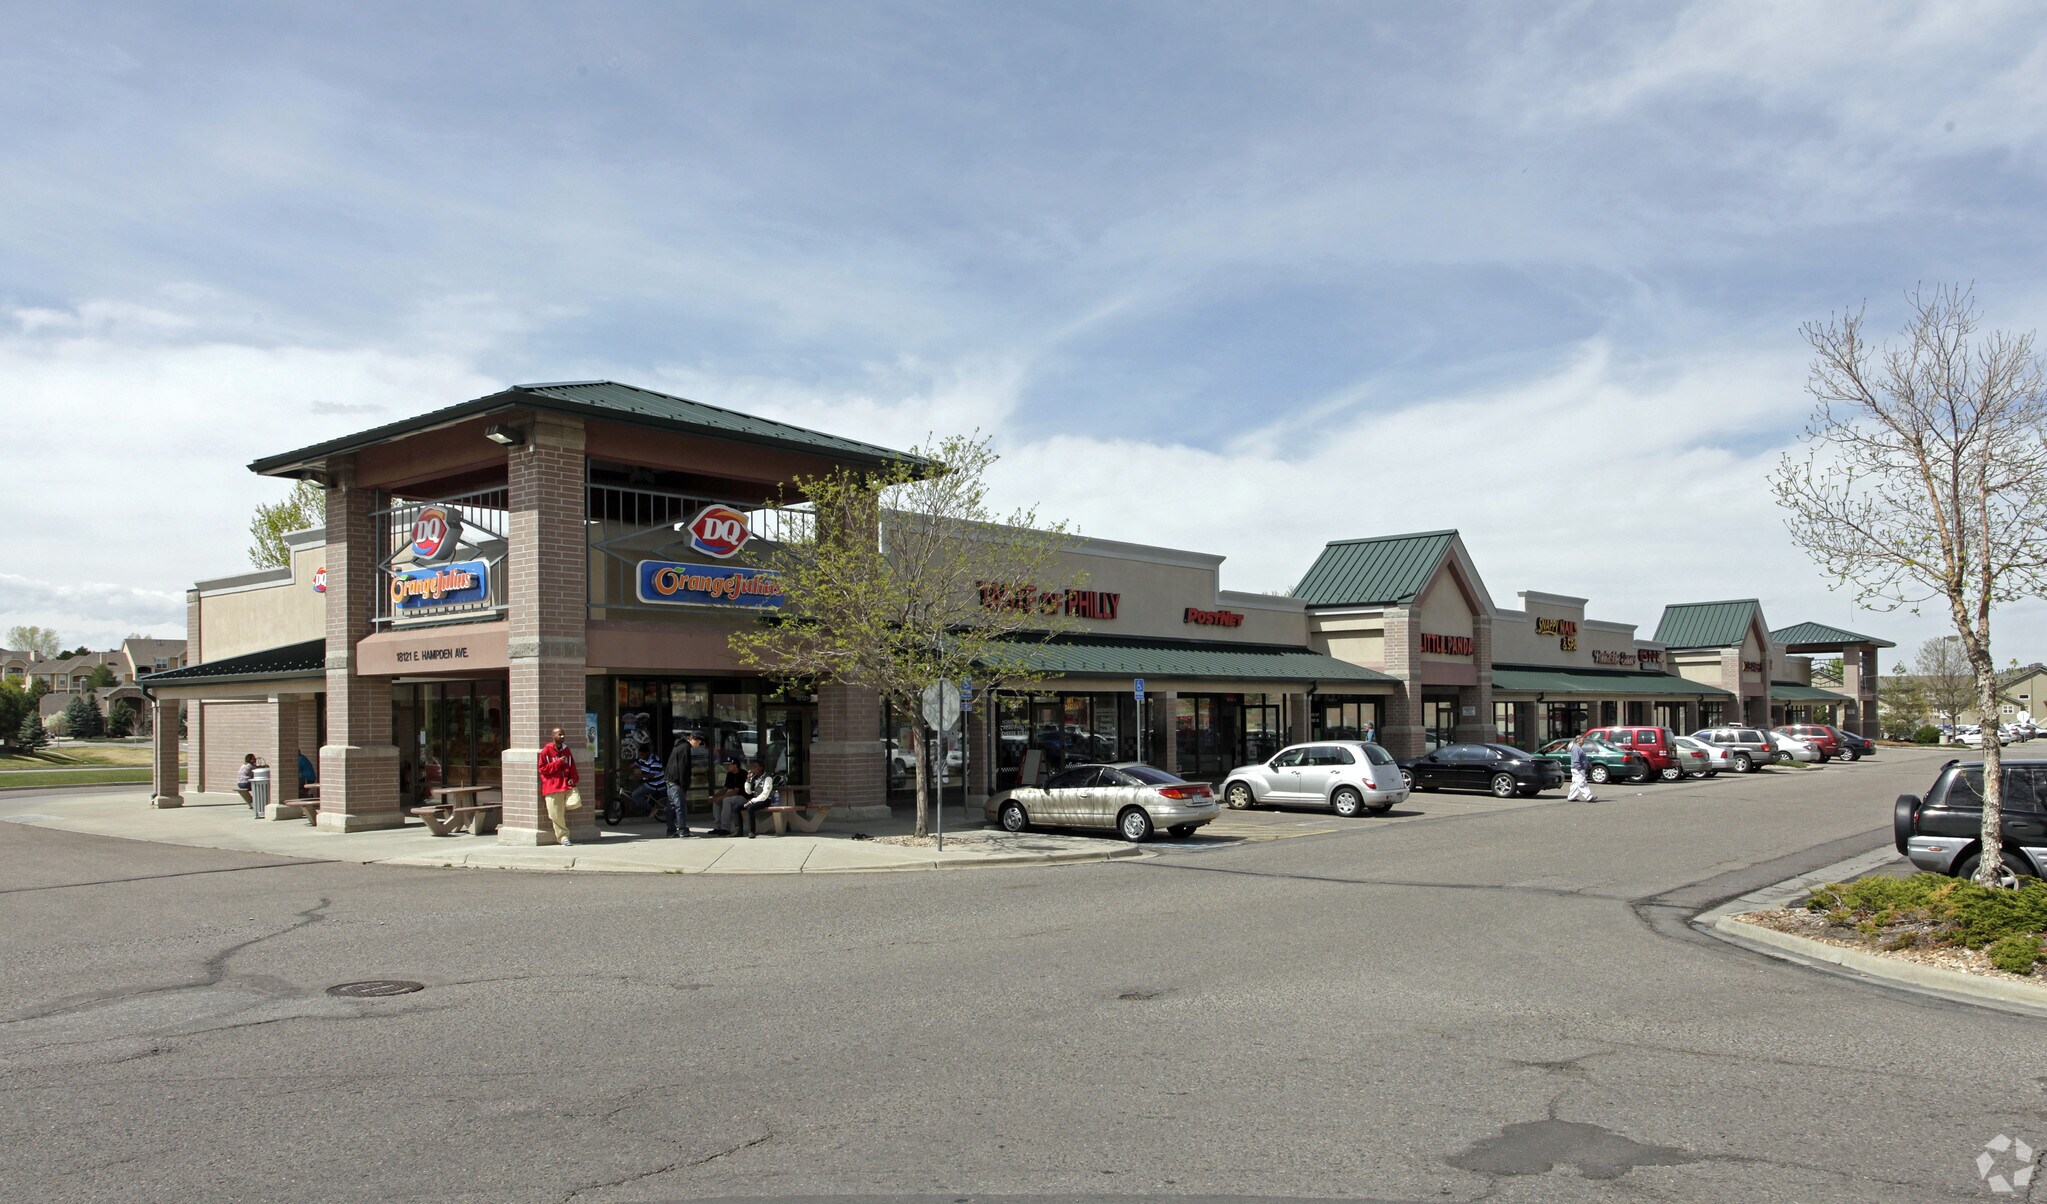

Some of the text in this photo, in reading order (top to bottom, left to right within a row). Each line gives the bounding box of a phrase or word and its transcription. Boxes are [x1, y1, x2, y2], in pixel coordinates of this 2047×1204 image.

[416, 517, 441, 543] DQ
[702, 517, 741, 545] DQ
[1065, 589, 1120, 619] PHILLY
[421, 648, 453, 660] HAMPDEN
[1420, 633, 1473, 656] LITTLE PANDA
